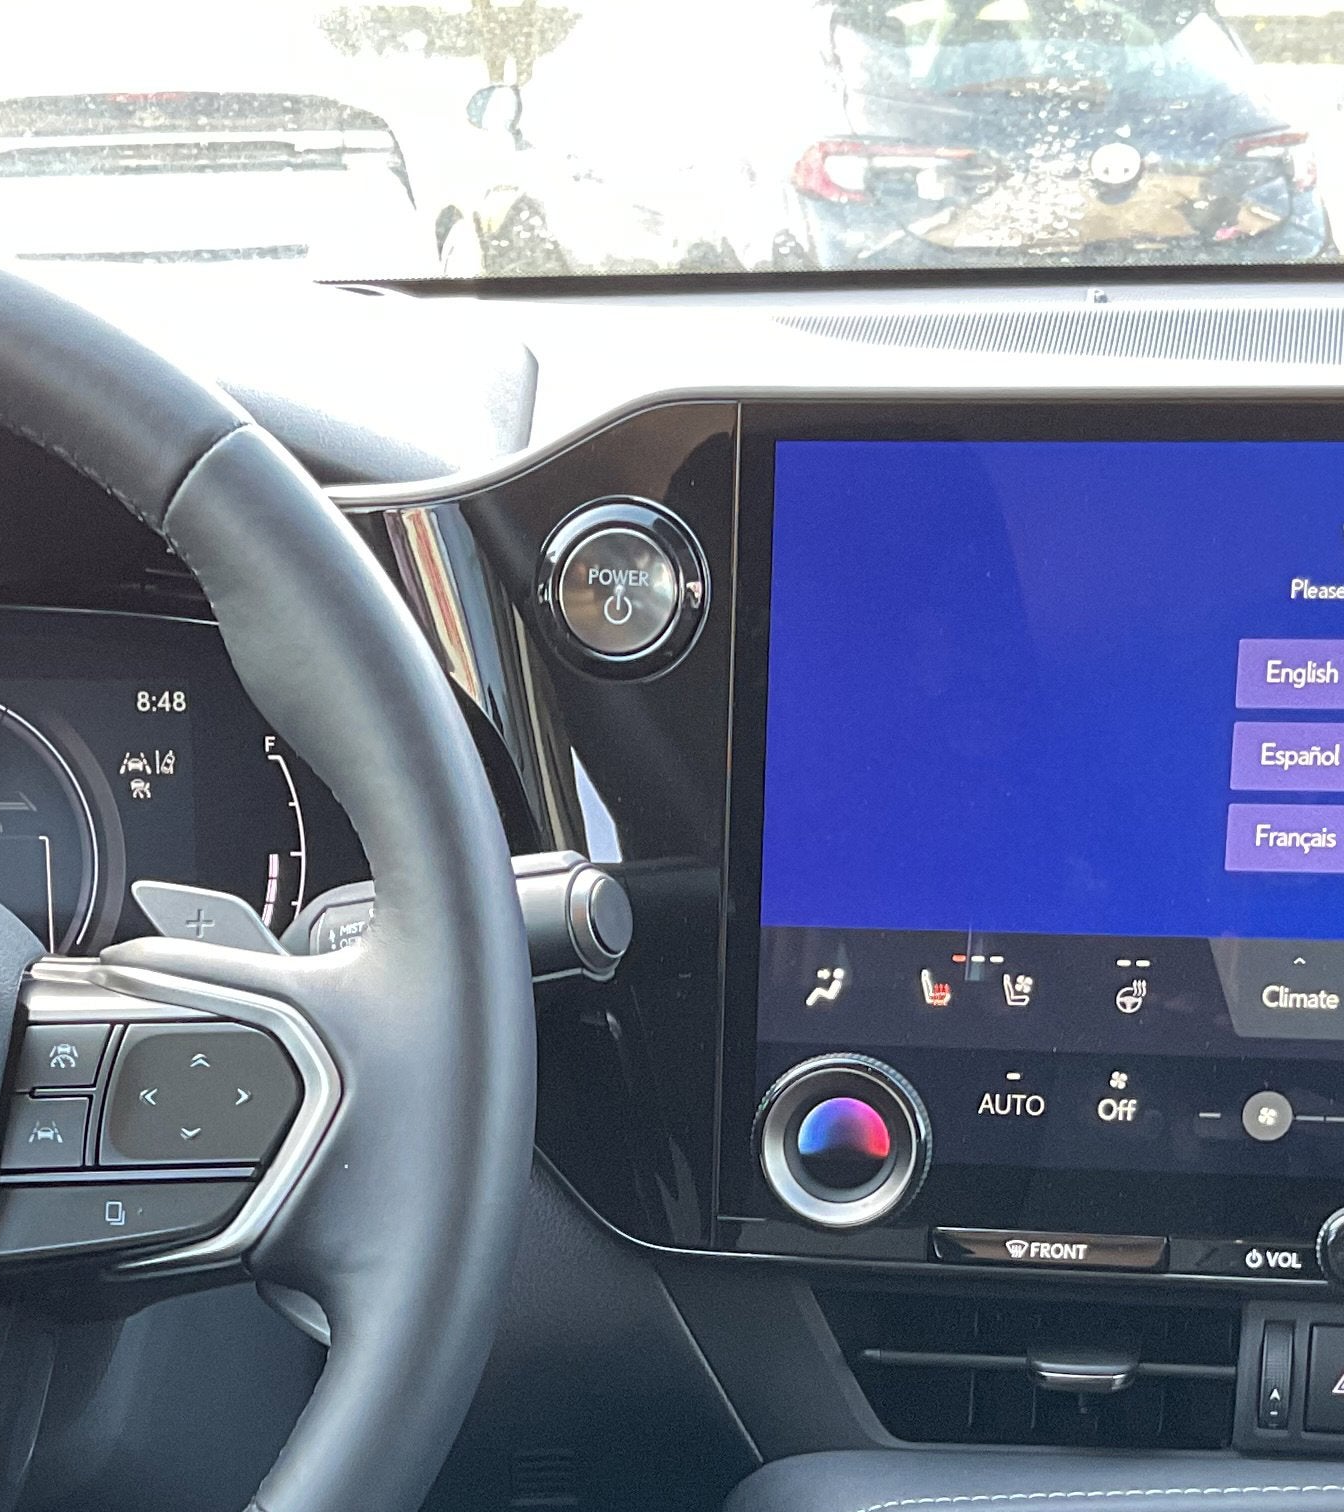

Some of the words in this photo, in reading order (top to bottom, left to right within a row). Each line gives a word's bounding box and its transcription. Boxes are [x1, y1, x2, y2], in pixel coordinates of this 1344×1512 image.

[588, 568, 649, 587] POWER
[1266, 659, 1339, 688] English
[136, 691, 187, 712] 8:48
[264, 735, 276, 753] F
[1260, 742, 1341, 771] Español
[1255, 823, 1337, 854] Français
[339, 921, 366, 937] MIST
[1262, 985, 1340, 1010] Climate
[978, 1092, 1045, 1118] AUTO
[1097, 1097, 1137, 1122] Off
[1029, 1241, 1088, 1261] FRONT
[1265, 1250, 1302, 1270] VOL
